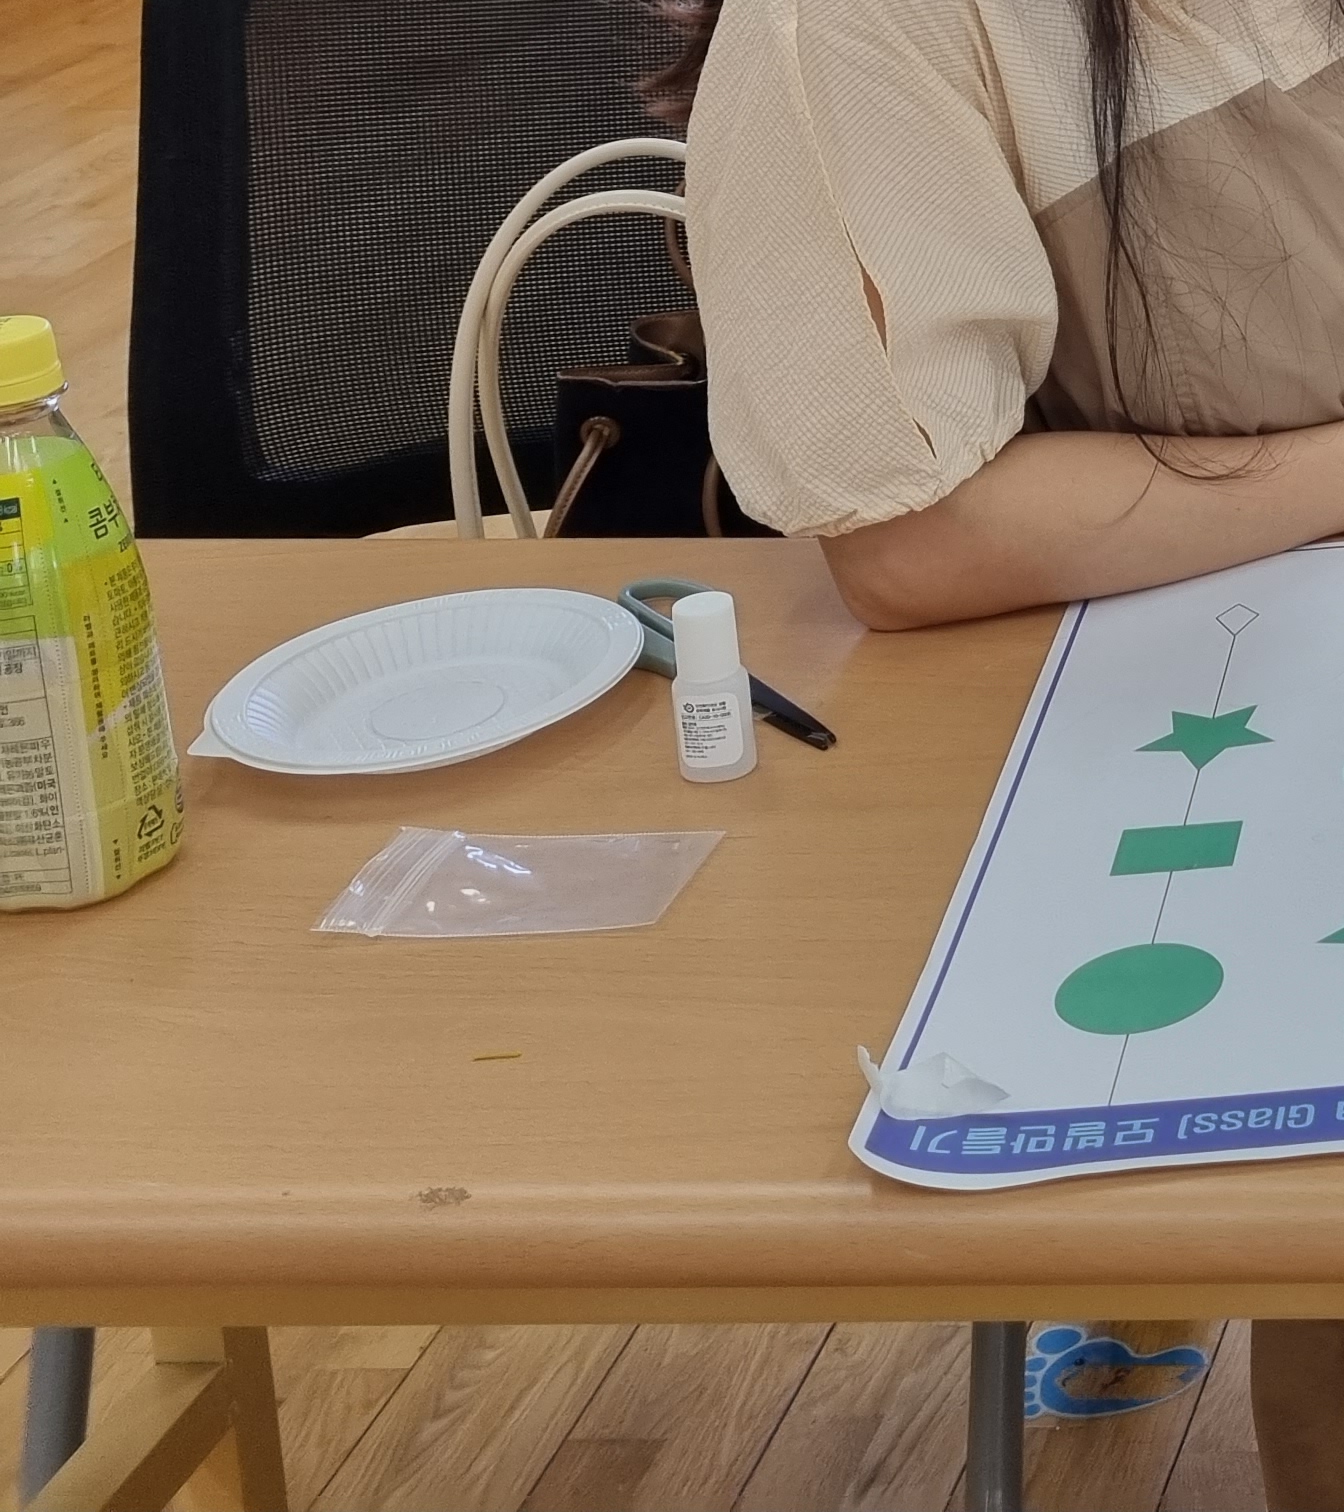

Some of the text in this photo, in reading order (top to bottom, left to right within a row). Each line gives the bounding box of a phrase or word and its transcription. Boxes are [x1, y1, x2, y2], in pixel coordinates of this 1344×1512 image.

[88, 492, 121, 540] 콤부
[909, 1117, 1160, 1156] 모빌만들기
[1176, 1103, 1316, 1140] Glass)
